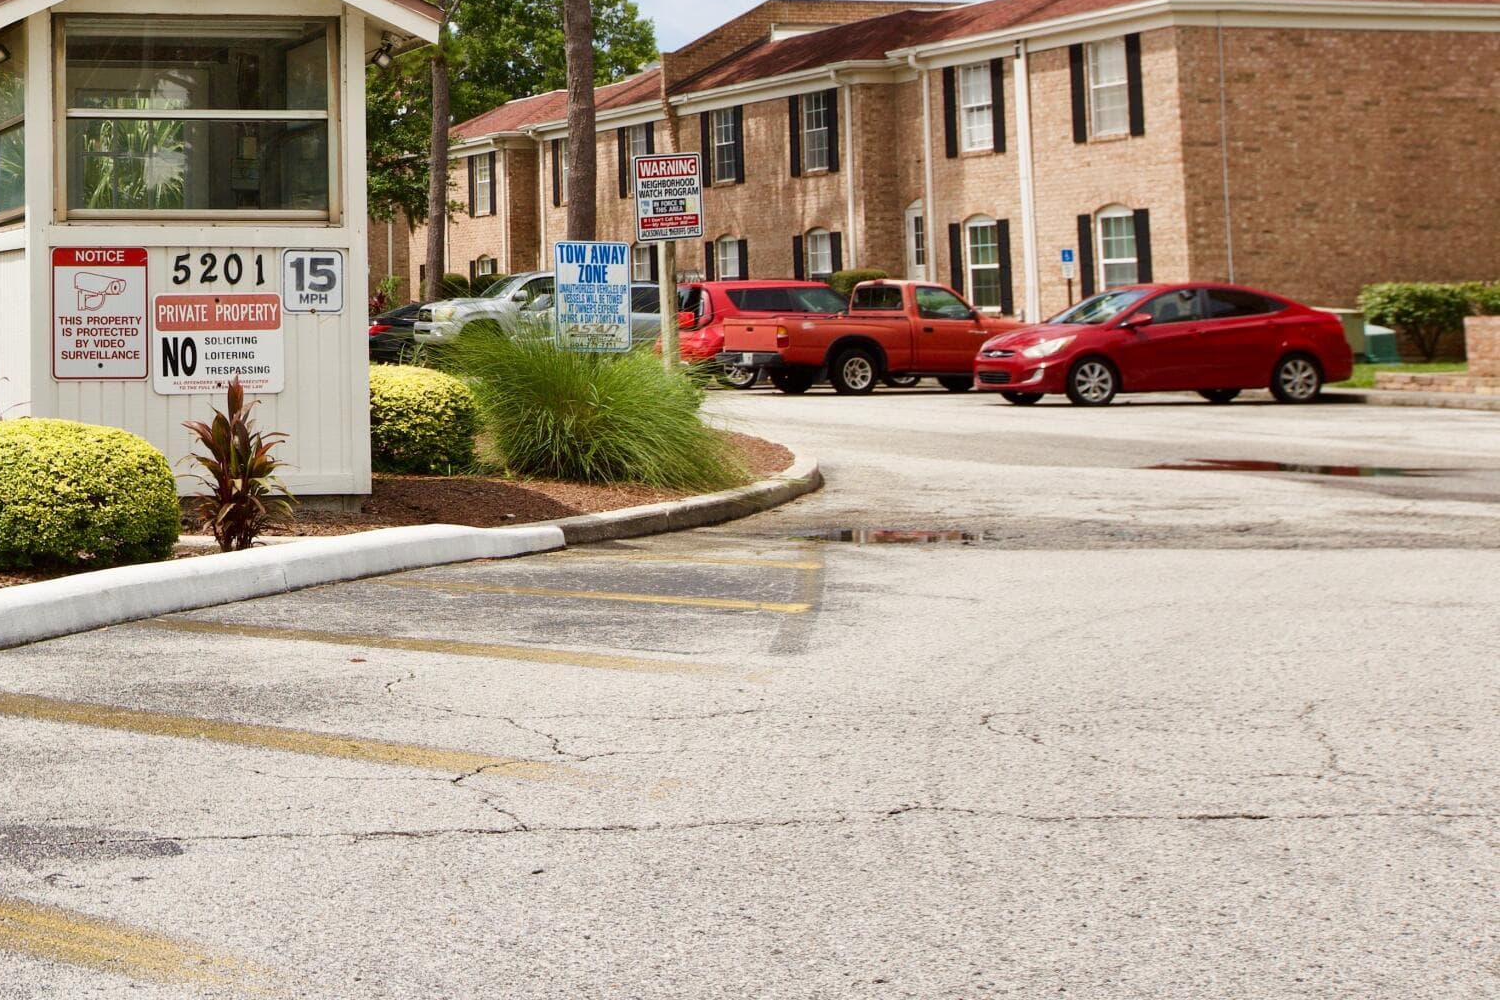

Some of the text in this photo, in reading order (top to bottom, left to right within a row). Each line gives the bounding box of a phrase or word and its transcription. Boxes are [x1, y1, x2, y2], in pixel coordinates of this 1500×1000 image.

[640, 159, 696, 177] WARNING
[641, 178, 694, 189] NEIGHBORHOOD
[638, 187, 698, 198] WATCH PROGRAM
[642, 229, 668, 238] JACKSONVILLE
[76, 250, 124, 262] NOTICE
[558, 244, 626, 264] TOW AWAY
[172, 252, 265, 286] 5201
[578, 264, 608, 283] ZONE
[290, 258, 337, 292] 15
[559, 284, 595, 293] UNAUTHORIZED
[597, 285, 619, 294] VEHICLES
[299, 294, 328, 304] MPH
[564, 294, 623, 304] VESSELS WILL BE TOWED
[158, 303, 278, 322] PRIVATE PROPERTY
[568, 304, 574, 312] AT
[598, 304, 619, 314] EXPENSE
[59, 316, 142, 325] THIS PROPERTY
[560, 314, 566, 323] 24
[585, 314, 594, 323] DAY
[600, 314, 612, 324] DAYS
[62, 328, 138, 336] IS PROTECTED
[76, 339, 125, 348] BY VIDEO
[204, 336, 258, 345] SOLICITING
[61, 351, 140, 359] SURVEILLANCE
[162, 337, 197, 377] NO
[205, 351, 255, 360] LOITERING
[205, 366, 270, 375] TRESPASSING
